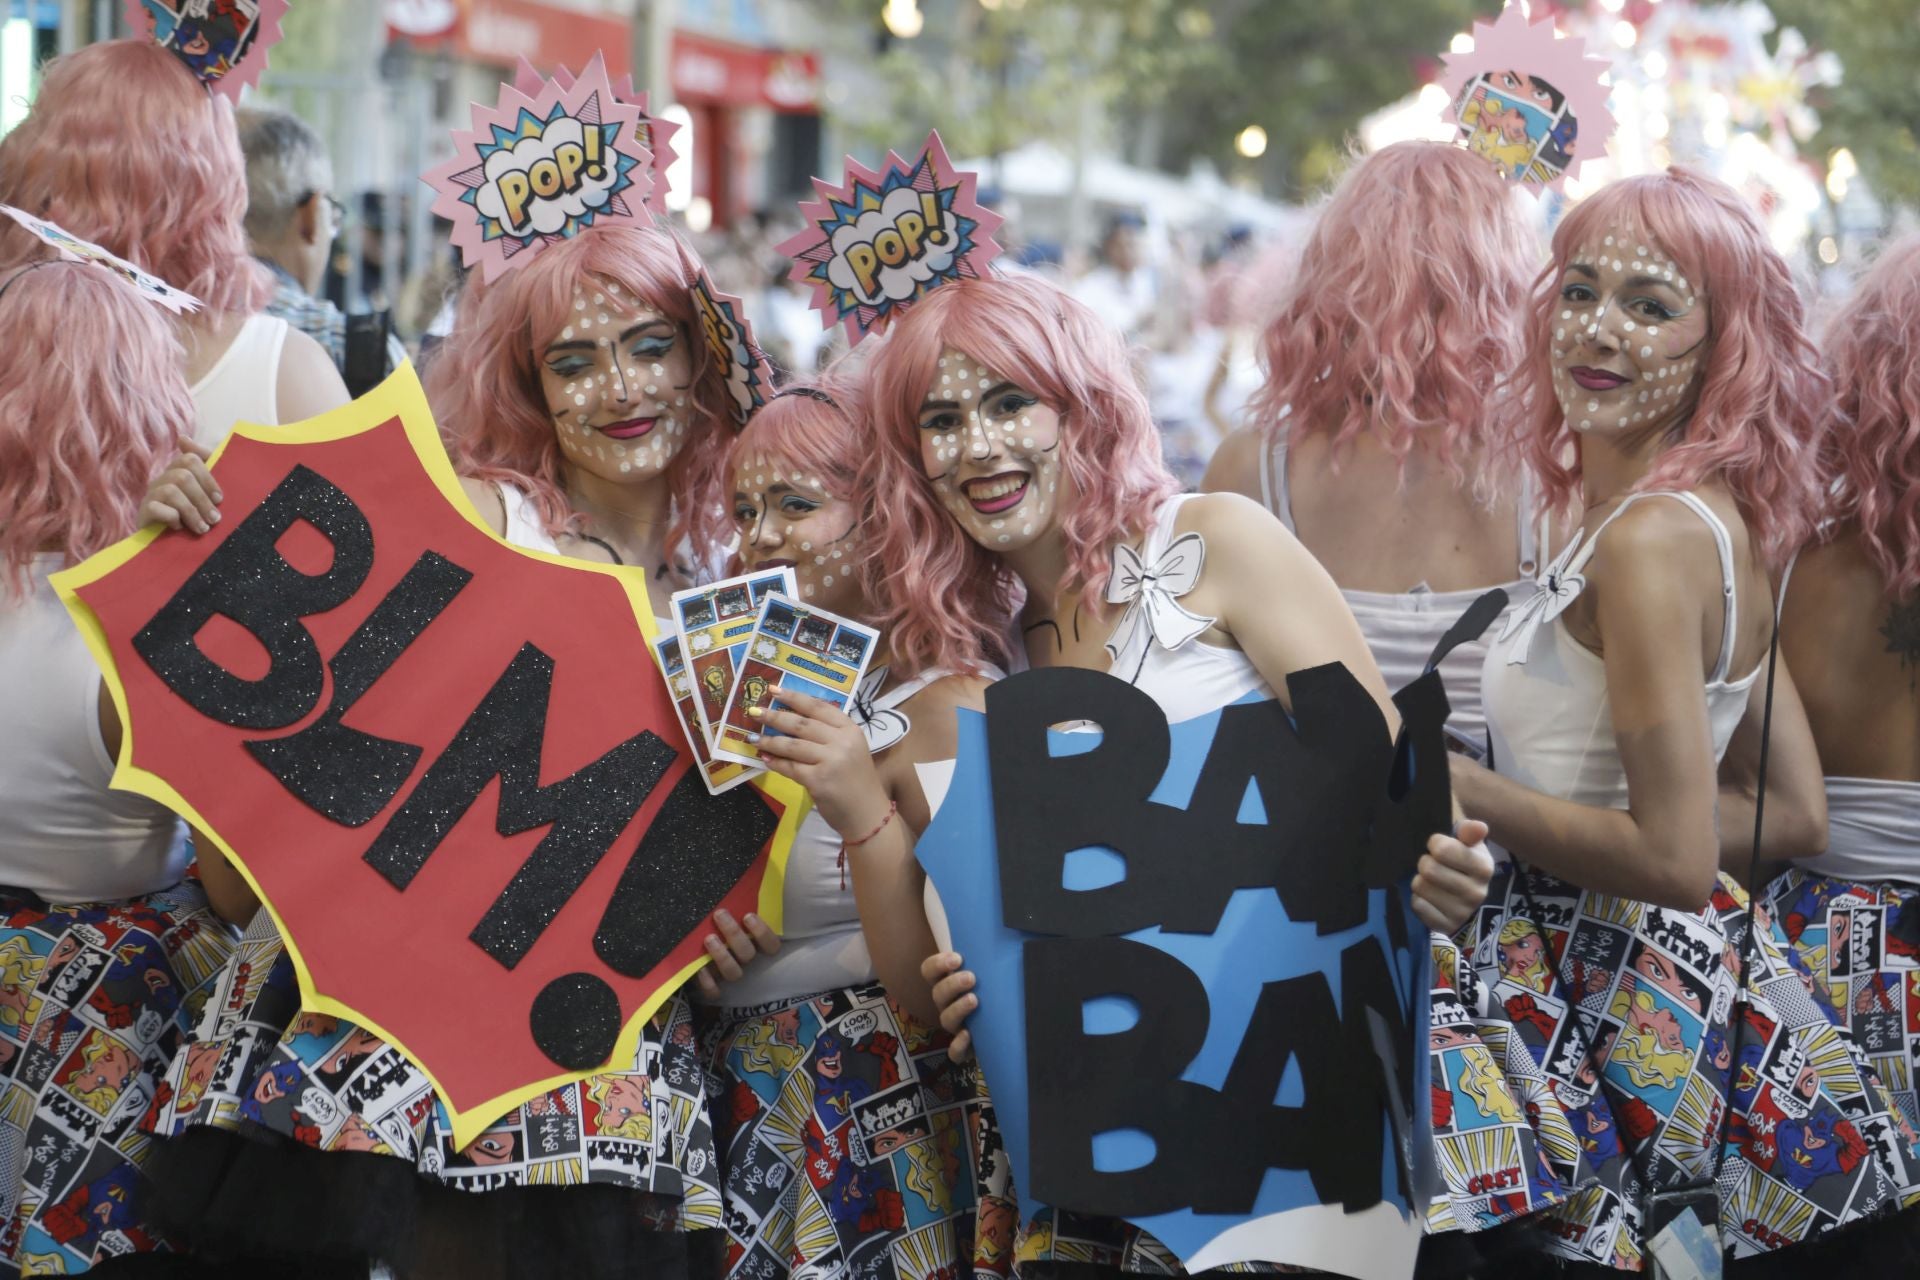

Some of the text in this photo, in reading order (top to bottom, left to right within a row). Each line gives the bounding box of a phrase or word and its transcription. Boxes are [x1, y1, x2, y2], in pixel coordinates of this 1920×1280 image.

[496, 124, 607, 232] POP!
[844, 192, 948, 299] POP!
[695, 286, 733, 379] OP!
[132, 463, 780, 1072] BIM!
[1516, 908, 1555, 922] CIY
[1589, 930, 1617, 963] BONK!
[1654, 930, 1702, 965] CITY
[1854, 921, 1865, 959] CITY
[62, 953, 88, 992] CITY
[229, 962, 252, 1009] CRET
[844, 1012, 869, 1028] LOOK
[1865, 1015, 1883, 1049] BONK!
[669, 1052, 692, 1085] BONK!
[1785, 1056, 1801, 1080] CIT
[310, 1092, 334, 1115] LOOK
[1561, 1084, 1587, 1098] LOOK
[1778, 1092, 1806, 1111] LOOK
[58, 1101, 97, 1126] CITY
[874, 1109, 908, 1131] CITY
[1748, 1112, 1776, 1135] BONK
[540, 1117, 560, 1152] BONK!
[824, 1135, 843, 1160] BONK
[854, 1132, 865, 1161] LOOK
[35, 1134, 56, 1164] BONK
[605, 1143, 641, 1156] CITY
[743, 1135, 759, 1169] RASH
[1752, 1141, 1775, 1160] BONK
[428, 1153, 439, 1175] LOO
[768, 1166, 785, 1185] LOOK
[815, 1158, 834, 1180] BONK
[744, 1166, 764, 1196] BONK
[1468, 1168, 1521, 1194] CRET
[1862, 1196, 1877, 1216] BON
